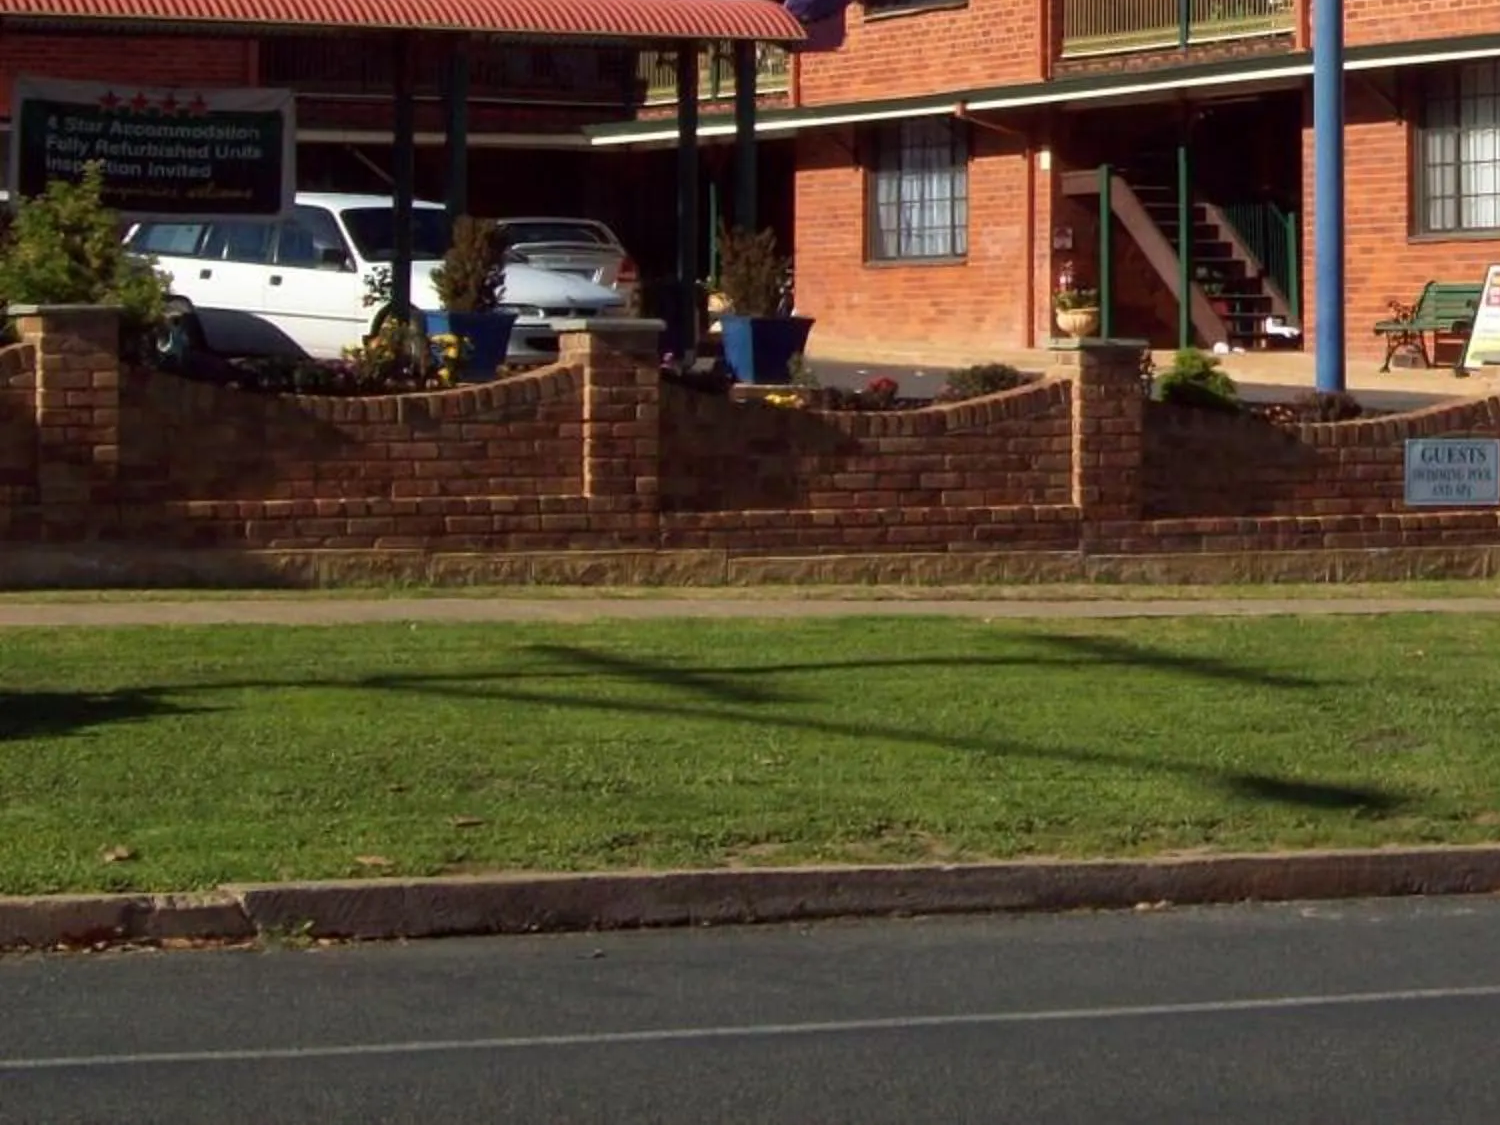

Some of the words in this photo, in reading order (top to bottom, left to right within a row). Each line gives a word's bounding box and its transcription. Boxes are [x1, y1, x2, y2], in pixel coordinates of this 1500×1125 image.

[109, 119, 261, 141] Accommodation
[46, 134, 91, 156] Fully
[95, 139, 210, 160] Refurbished
[215, 143, 264, 160] Units
[46, 154, 142, 177] Inspction
[149, 161, 213, 179] Invited
[1421, 446, 1488, 464] GUESTS
